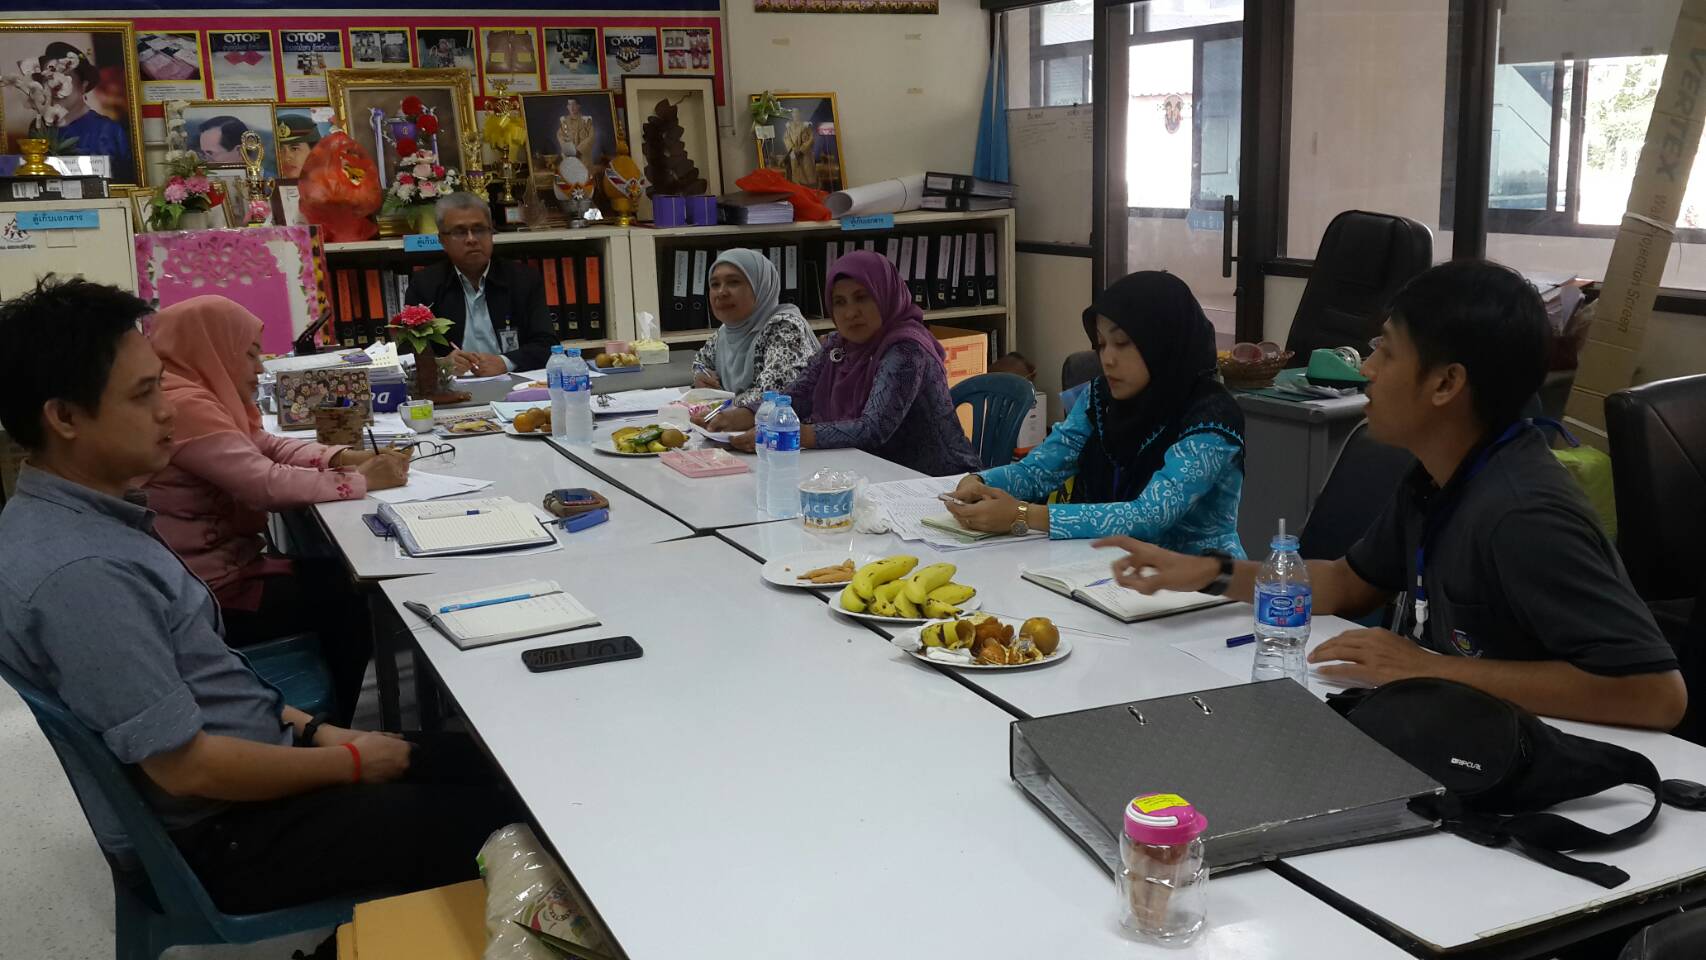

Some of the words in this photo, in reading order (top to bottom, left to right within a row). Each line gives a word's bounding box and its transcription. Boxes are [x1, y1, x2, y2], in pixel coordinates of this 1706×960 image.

[223, 33, 261, 44] OTOP
[286, 32, 326, 43] OTOP
[1655, 48, 1706, 183] VERTEX
[32, 213, 83, 225] ตู้เก็บเอกสาร
[1617, 289, 1641, 334] Screen
